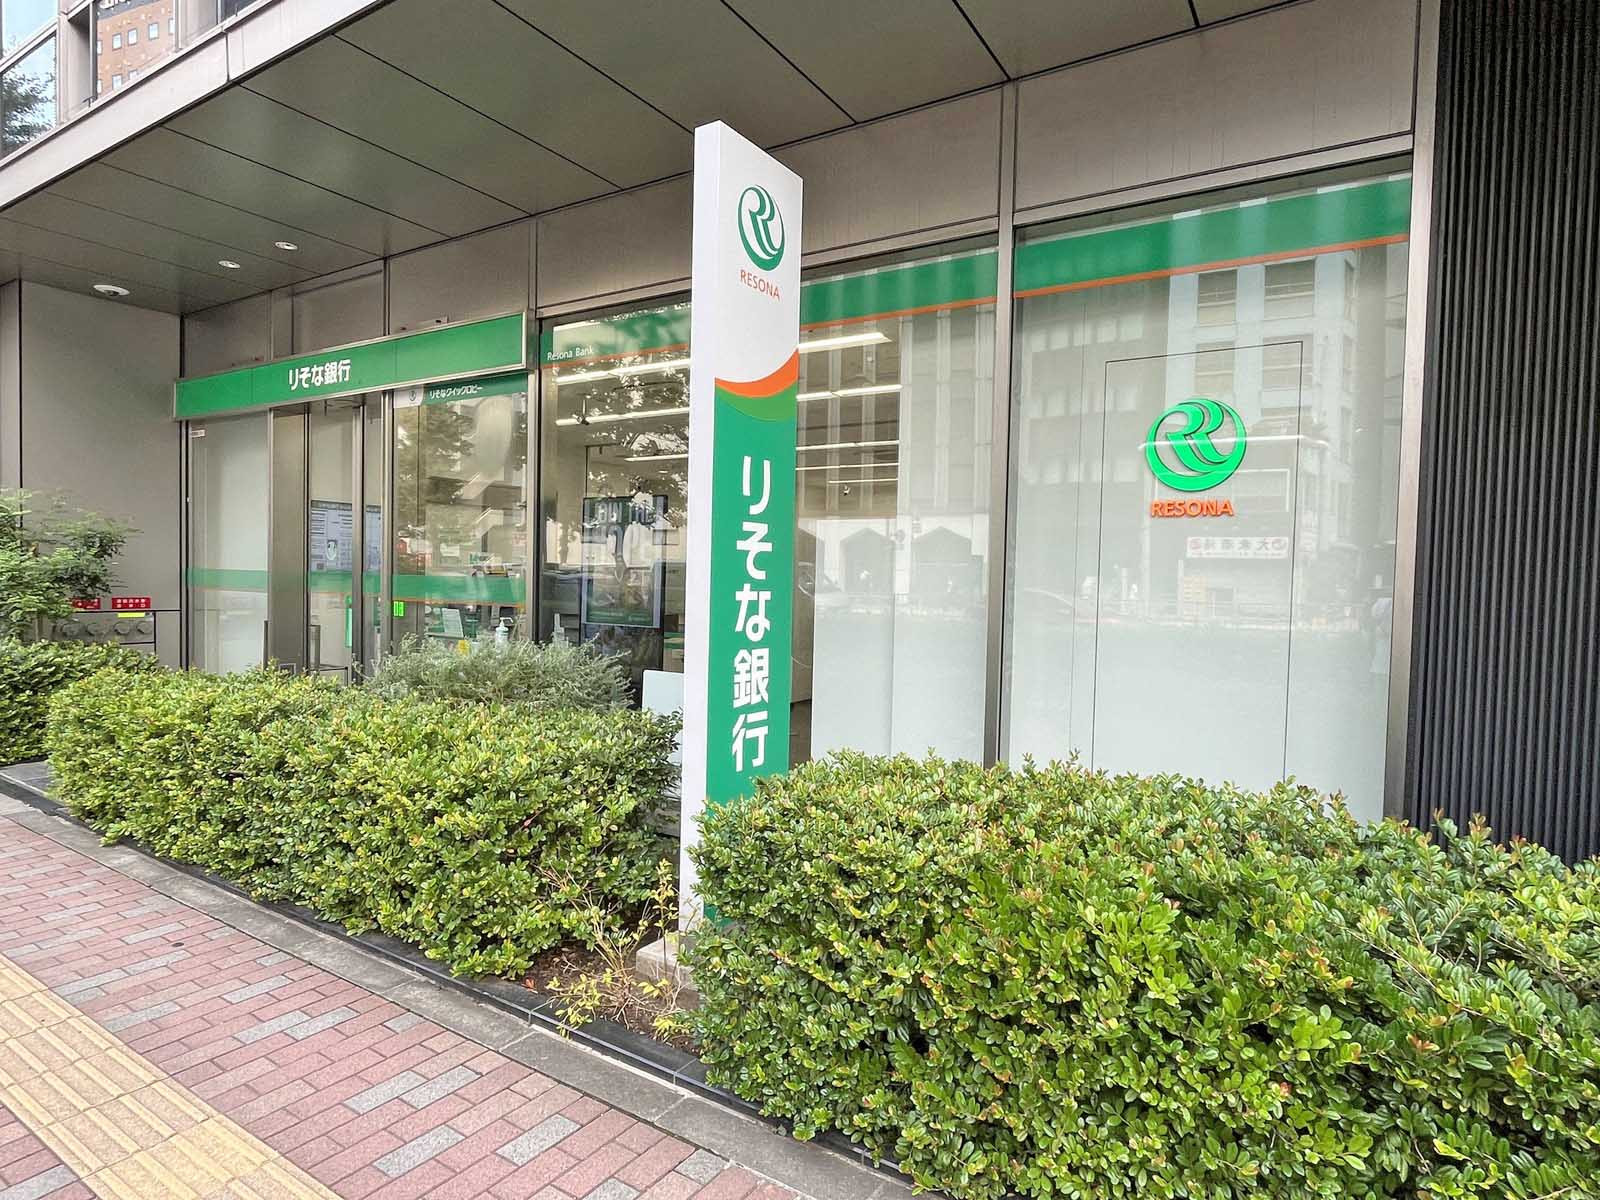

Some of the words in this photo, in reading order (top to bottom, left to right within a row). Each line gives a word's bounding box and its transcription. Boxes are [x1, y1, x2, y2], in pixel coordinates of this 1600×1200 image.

[740, 269, 781, 300] RESONA
[547, 350, 573, 361] Resona
[575, 345, 594, 357] Bank
[288, 359, 351, 390] りそな銀行
[1151, 499, 1235, 518] RESONA
[731, 455, 773, 773] りそな銀行
